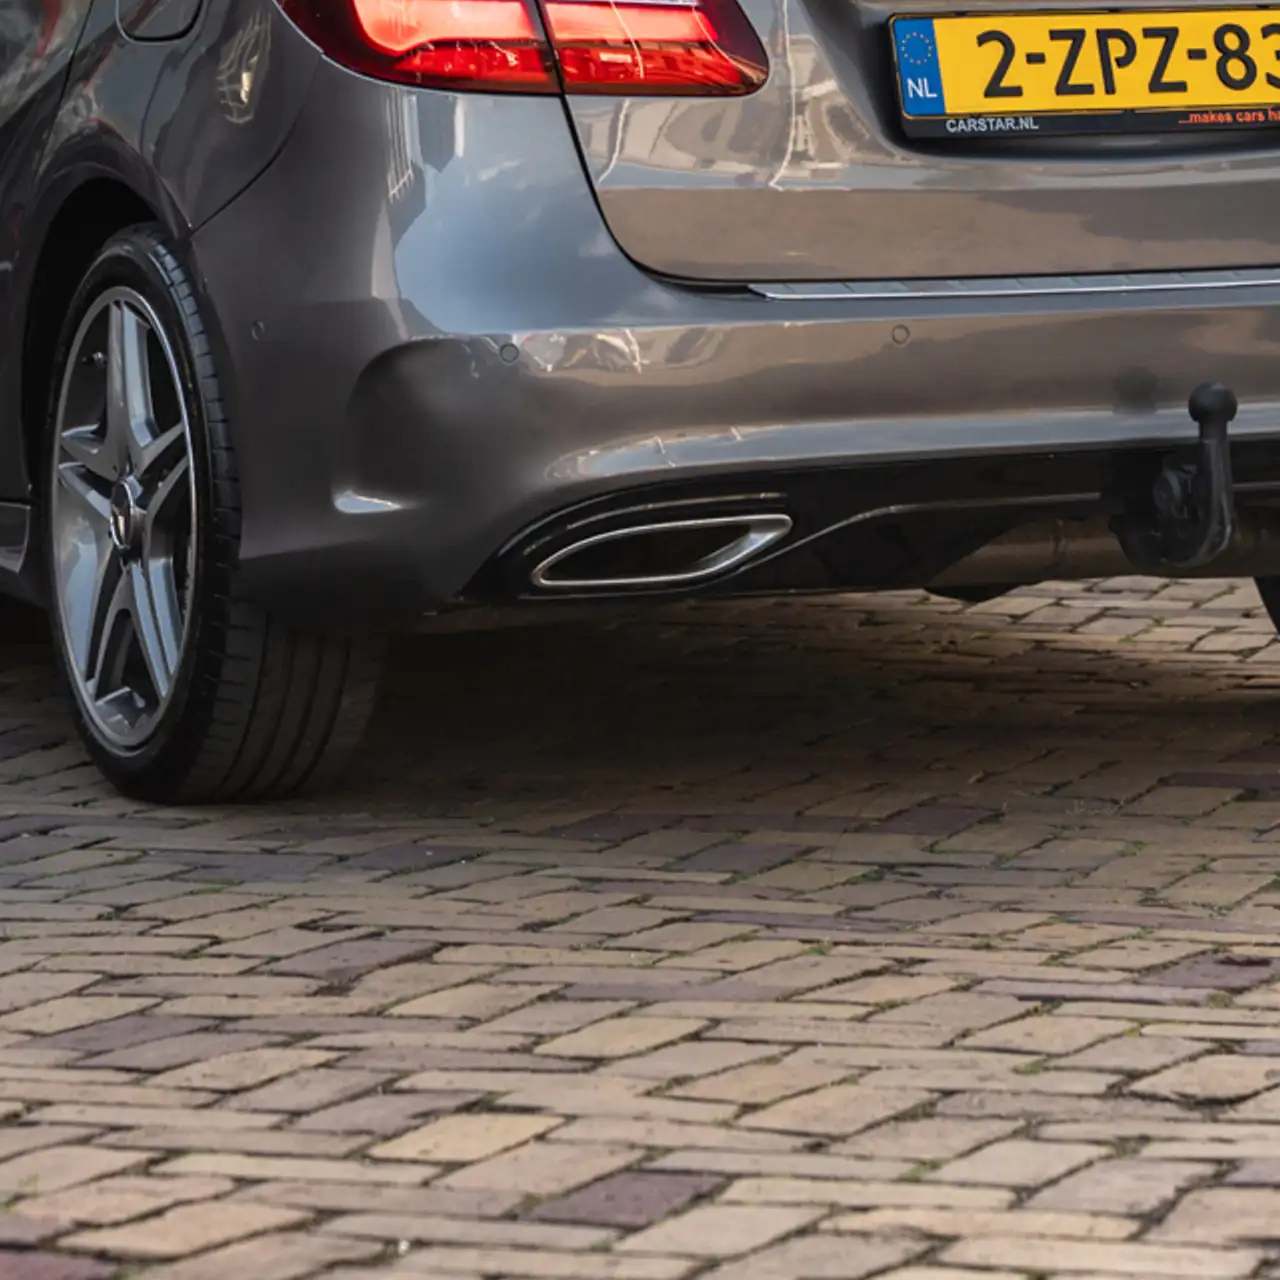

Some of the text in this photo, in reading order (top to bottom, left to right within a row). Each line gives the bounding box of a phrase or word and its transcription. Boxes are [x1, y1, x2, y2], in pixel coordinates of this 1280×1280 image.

[907, 77, 937, 99] NL
[945, 116, 1040, 133] CARSTAR.NL
[1235, 111, 1266, 124] cars
